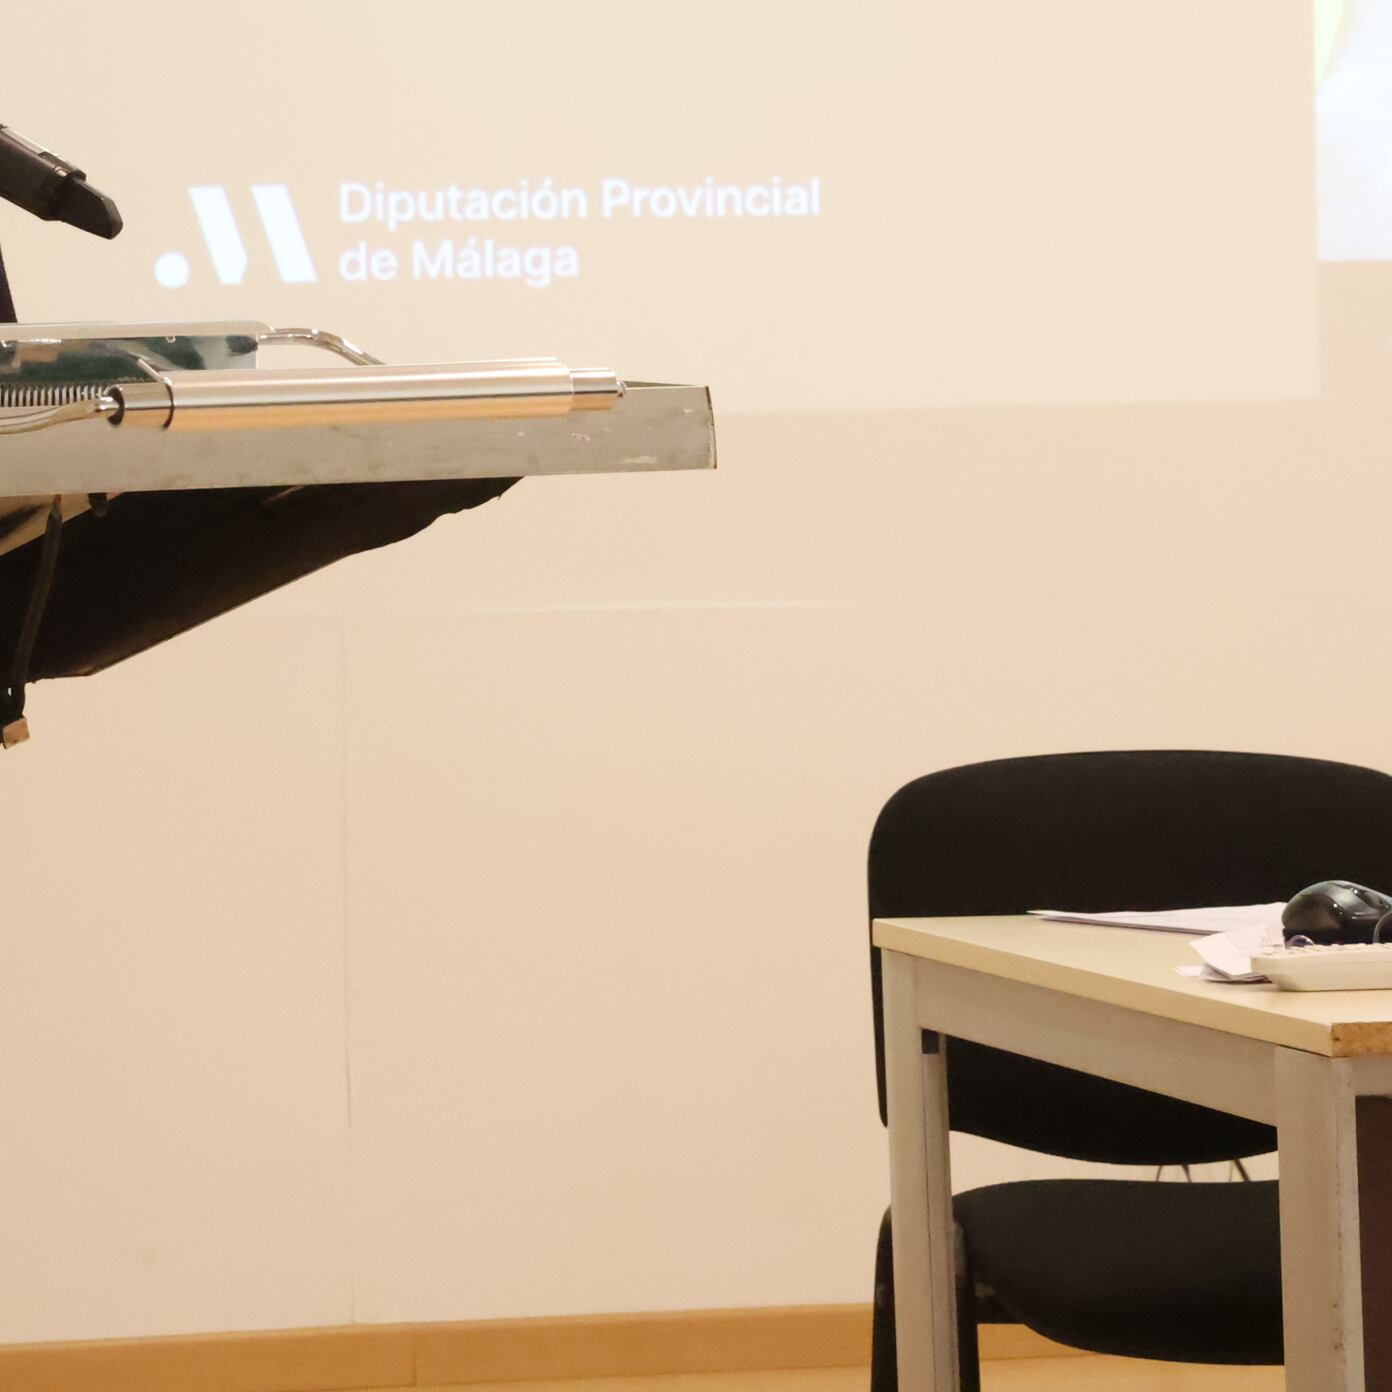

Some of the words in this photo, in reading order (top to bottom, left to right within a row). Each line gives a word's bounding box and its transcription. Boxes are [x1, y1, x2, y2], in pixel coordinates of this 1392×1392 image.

[338, 179, 588, 231] Diputación
[602, 177, 822, 220] Provincial
[338, 242, 398, 283] de
[411, 239, 580, 288] Málaga
